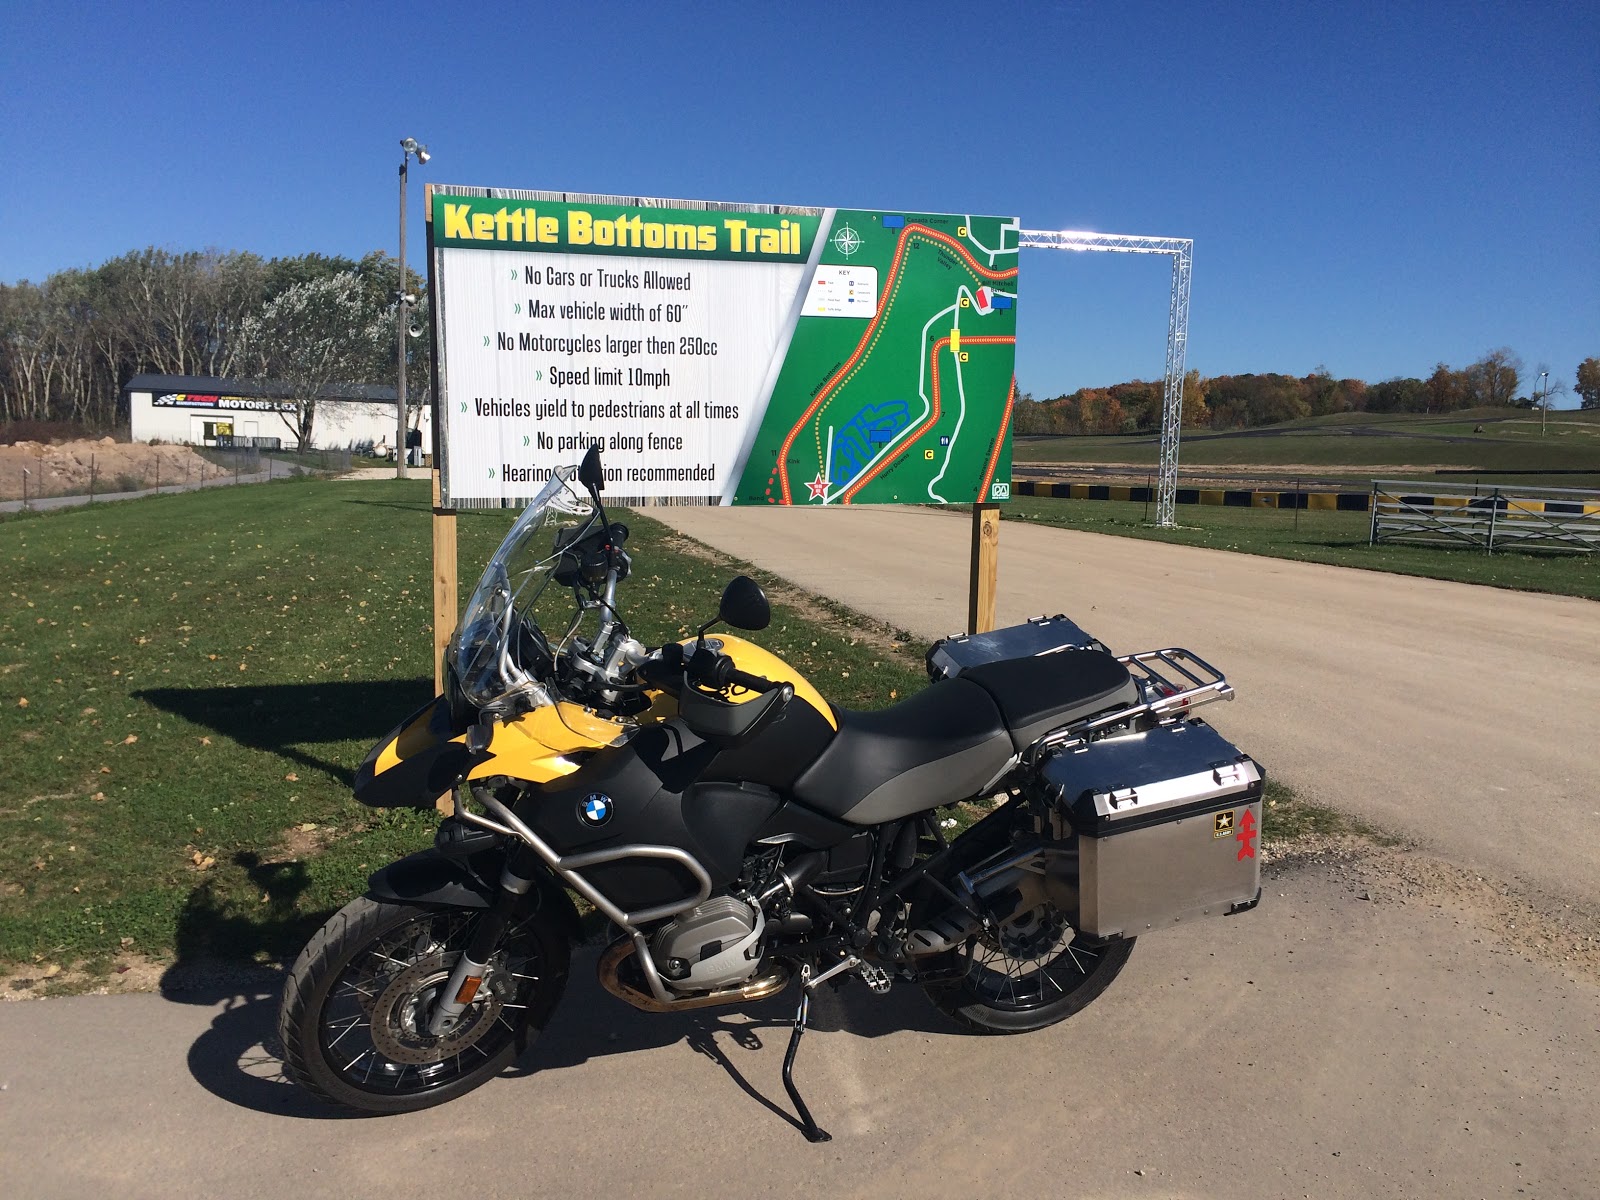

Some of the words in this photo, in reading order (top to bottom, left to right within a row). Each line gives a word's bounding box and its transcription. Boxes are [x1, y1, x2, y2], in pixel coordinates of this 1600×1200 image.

[444, 203, 559, 244] Kettle
[568, 210, 717, 252] Bottoms
[724, 219, 801, 255] Trail
[959, 227, 966, 236] C
[937, 256, 952, 270] Valley
[525, 266, 541, 285] No
[546, 266, 575, 287] Cars
[580, 273, 593, 287] or
[597, 268, 639, 289] Trucks
[643, 271, 691, 291] Allowed
[528, 299, 555, 319] Max
[560, 300, 605, 321] vehicle
[609, 302, 645, 322] width
[649, 304, 662, 323] of
[961, 299, 968, 307] C
[497, 332, 515, 351] No
[519, 332, 601, 356] Motorcycles
[605, 334, 643, 357] larger
[646, 336, 676, 355] then
[679, 336, 718, 356] 250cc
[960, 353, 967, 361] C
[549, 366, 590, 388] Speed
[594, 367, 623, 386] limit
[627, 368, 671, 390] 10mph
[475, 397, 531, 417] Vehicles
[535, 398, 567, 421] yield
[571, 400, 585, 418] to
[589, 401, 665, 421] pedestrians
[669, 403, 682, 419] at
[686, 401, 700, 419] all
[703, 401, 740, 420] times
[537, 431, 554, 450] No
[558, 431, 605, 453] parking
[609, 432, 643, 453] along
[648, 432, 683, 450] fence
[925, 450, 933, 459] C
[627, 464, 715, 482] recommended
[581, 794, 608, 807] BMW
